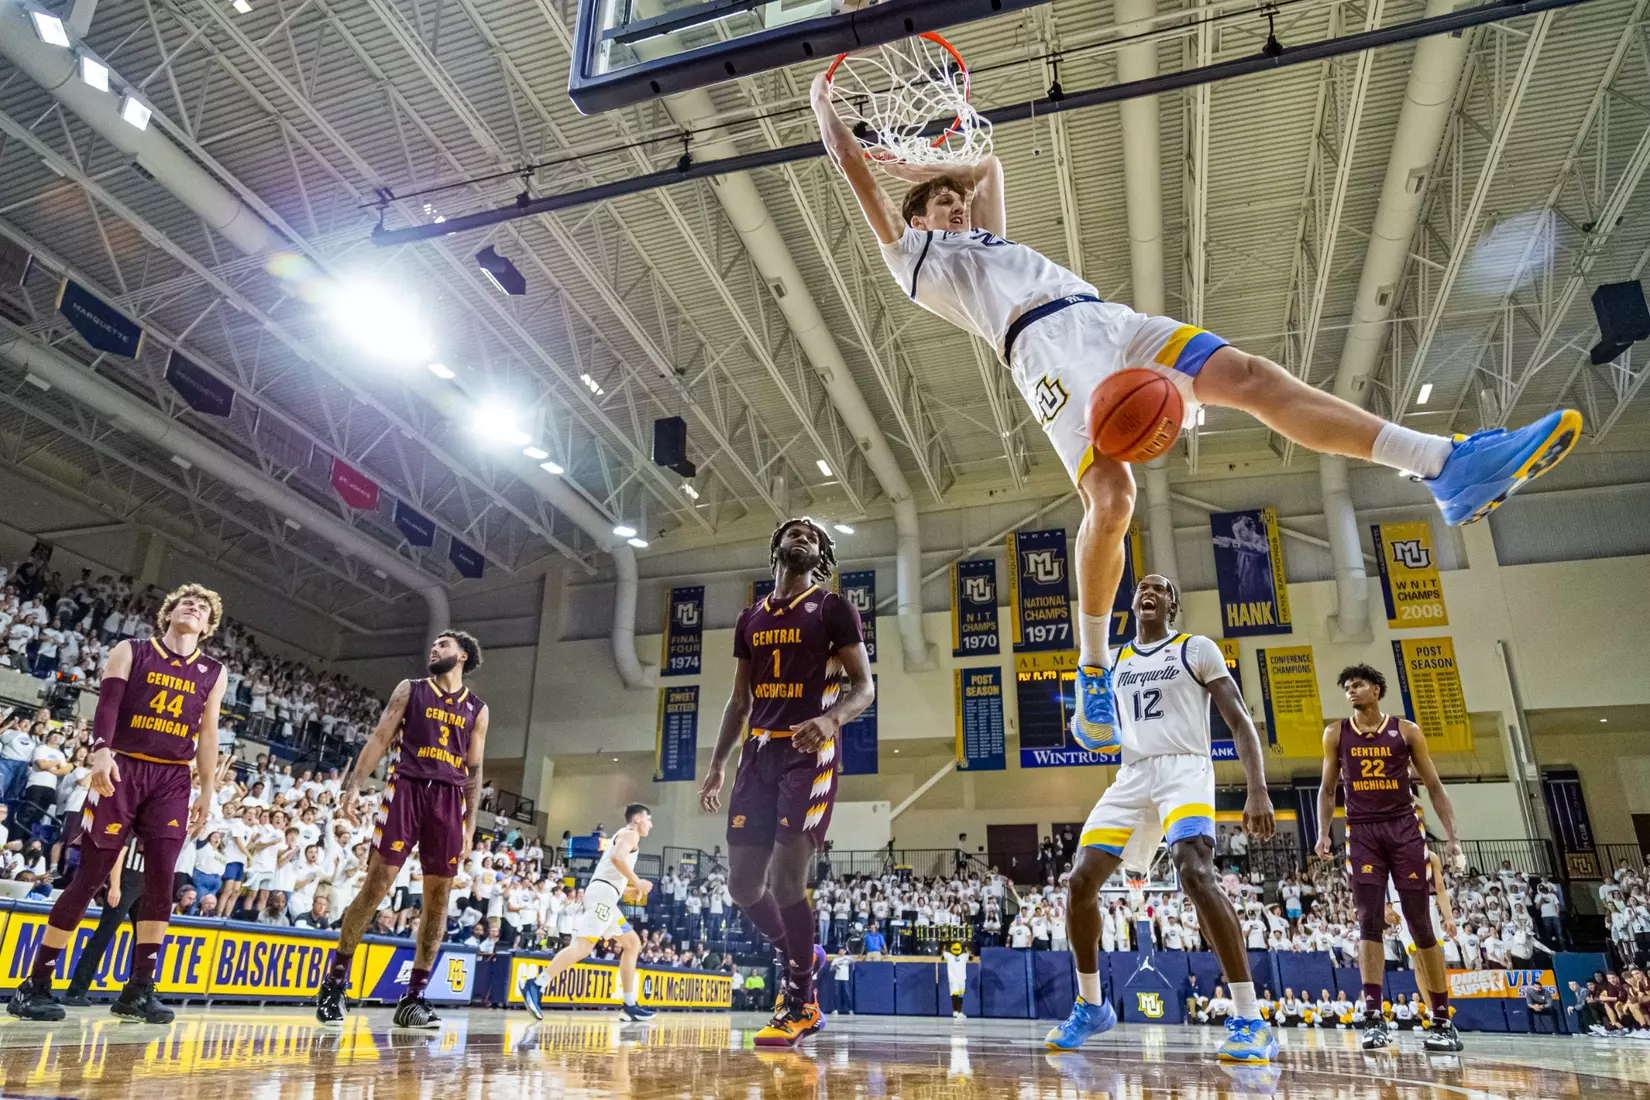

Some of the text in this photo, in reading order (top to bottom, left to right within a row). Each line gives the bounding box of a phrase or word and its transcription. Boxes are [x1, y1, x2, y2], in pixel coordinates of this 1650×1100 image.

[72, 302, 130, 344] MARQUETTE
[1390, 540, 1432, 569] MU
[1022, 548, 1065, 585] MU
[1271, 537, 1289, 621] HANK RAYMONDS
[961, 575, 995, 604] MU
[1397, 590, 1440, 601] CHAMPS
[1024, 595, 1067, 608] NATIONAL
[673, 600, 702, 627] MU
[1024, 607, 1068, 621] CHAMPS
[1226, 601, 1274, 627] HANK
[1400, 603, 1444, 620] 2008
[963, 622, 996, 632] CHAMPS
[1025, 623, 1069, 643] 1977
[671, 635, 700, 644] FINAL
[752, 628, 802, 647] CENTRAL
[963, 634, 997, 649] 1970
[671, 644, 700, 653] FOUR
[1416, 646, 1442, 657] POST
[670, 656, 699, 669] 1974
[772, 649, 781, 678] 1
[1270, 654, 1311, 665] CONFERENCE
[1411, 658, 1453, 670] SEASON
[1018, 672, 1031, 681] PLY
[1043, 671, 1057, 680] PTS
[1117, 665, 1180, 688] Marquette
[1272, 664, 1312, 675] CHAMPIONS
[147, 672, 196, 694] CENTRAL
[971, 674, 993, 685] POST
[669, 692, 695, 703] SWEET
[966, 686, 1000, 697] SEASON
[150, 690, 185, 718] 44
[667, 703, 696, 713] SIXTEEN
[1132, 688, 1164, 721] 12
[130, 715, 189, 738] MICHIGAN
[425, 707, 466, 729] CENTRAL
[438, 726, 450, 746] 3
[1351, 747, 1392, 757] CENTRAL
[1360, 759, 1386, 777] 22
[1353, 780, 1399, 791] MICHIGAN
[215, 939, 353, 990] BASKETBA
[447, 958, 467, 992] MU
[538, 965, 612, 1001] ARQUETTE
[1451, 969, 1505, 983] DIRECT
[653, 975, 664, 1000] AL
[666, 976, 704, 1001] McGUIRE
[705, 979, 731, 1003] CENTER
[1452, 979, 1505, 997] SUPPLY
[1136, 992, 1164, 1018] MU
